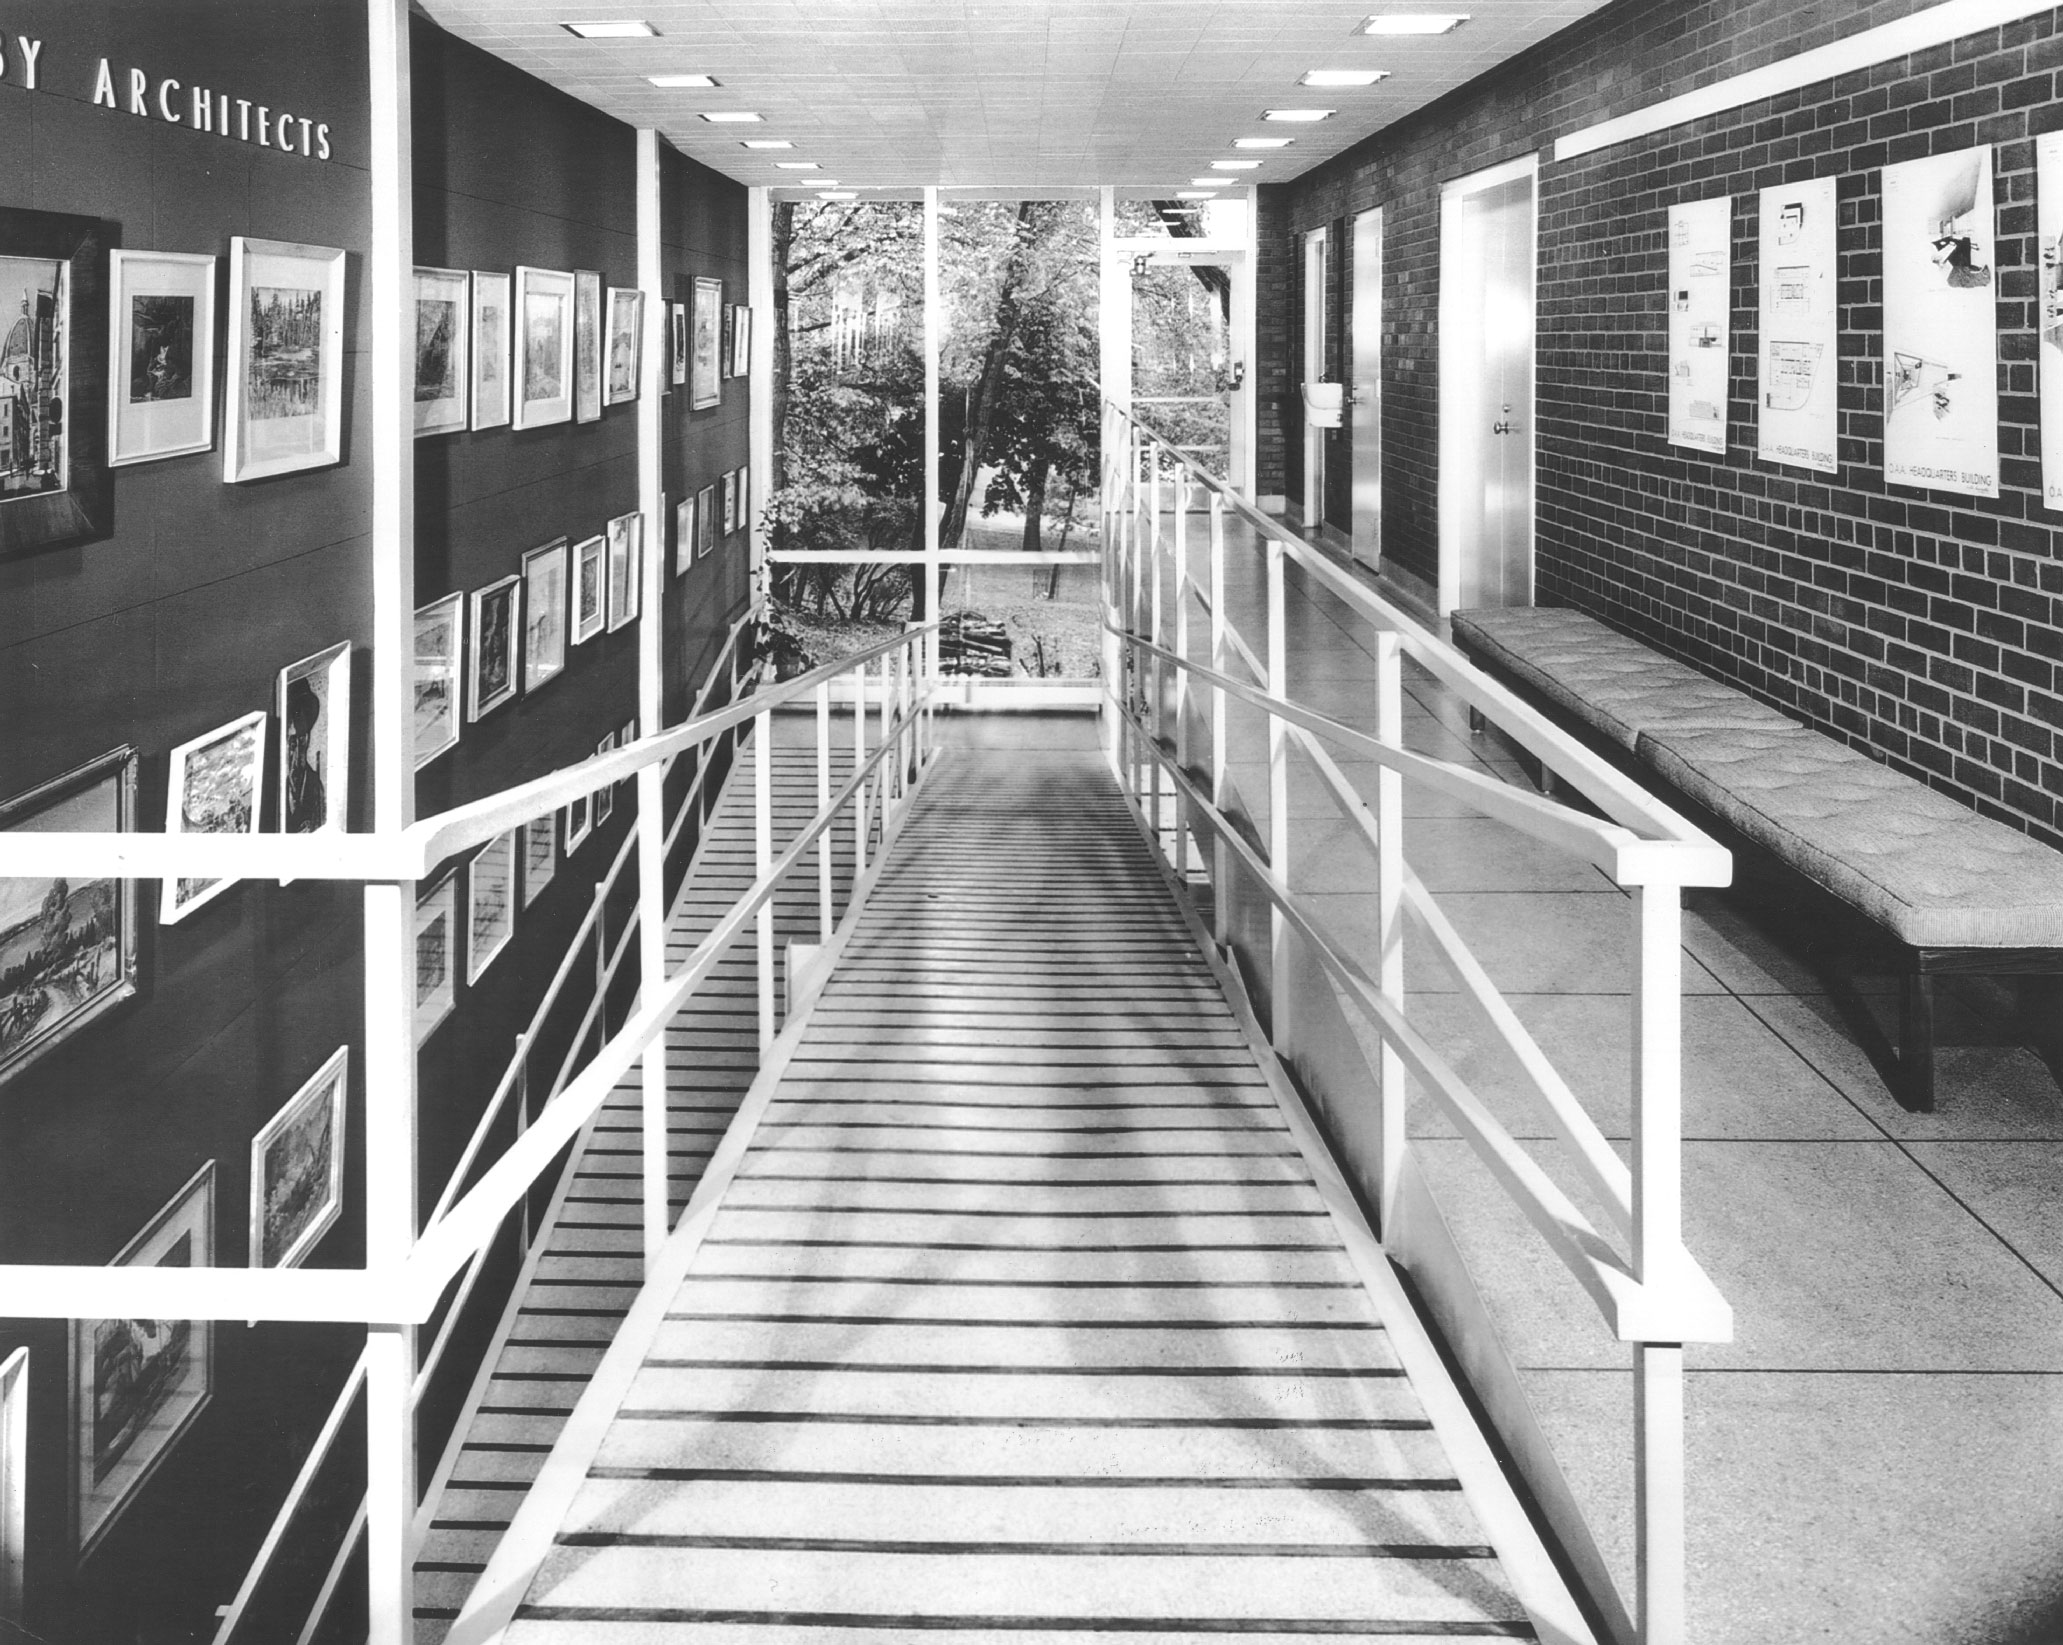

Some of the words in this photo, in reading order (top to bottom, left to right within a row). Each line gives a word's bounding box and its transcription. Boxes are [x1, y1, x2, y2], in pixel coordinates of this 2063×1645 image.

[0, 36, 42, 90] Y
[93, 57, 331, 160] ARCHITECTS
[1811, 451, 1833, 464] BUILDING
[1909, 465, 1958, 482] HEADQUARTERS
[1961, 472, 1992, 487] BUILDING
